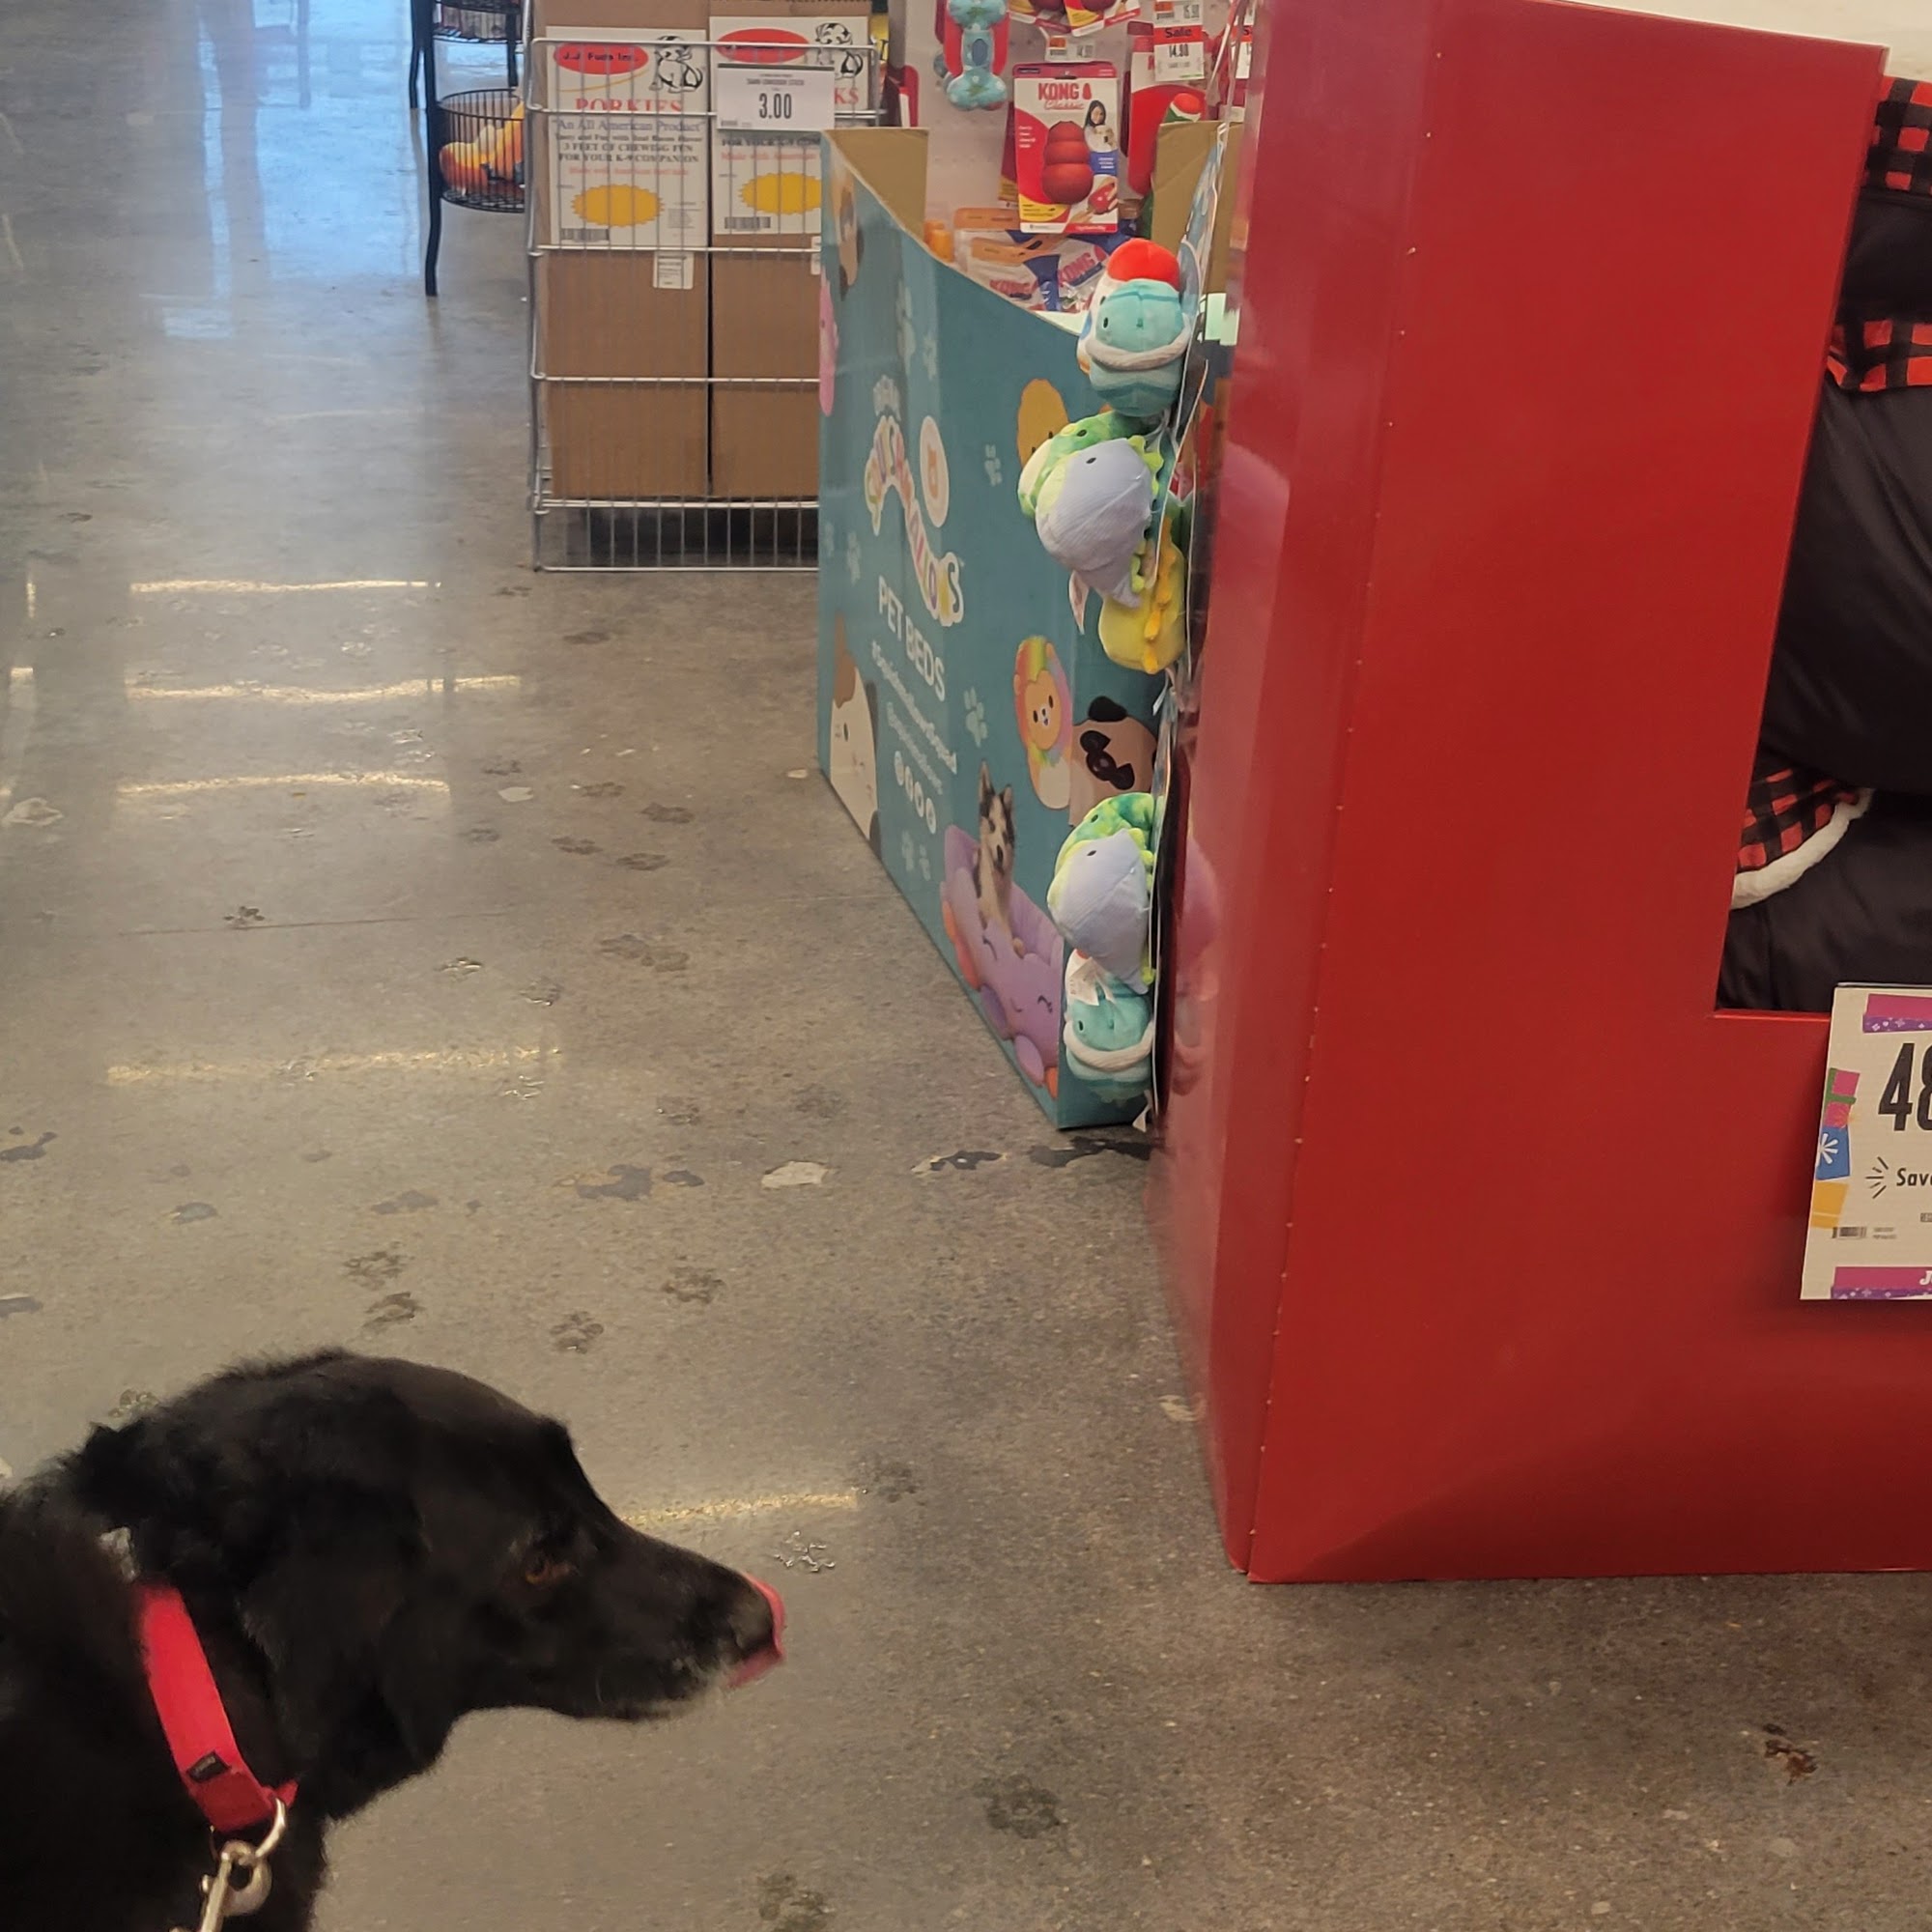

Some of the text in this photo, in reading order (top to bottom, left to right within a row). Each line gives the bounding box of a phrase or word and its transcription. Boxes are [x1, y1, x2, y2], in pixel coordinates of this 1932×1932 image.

[1165, 27, 1192, 38] Sale
[1037, 83, 1080, 100] KONG
[575, 98, 683, 112] PORKIES
[759, 93, 792, 119] 3.00
[599, 120, 653, 130] American
[878, 575, 904, 641] PET
[905, 614, 946, 702] BEDS
[1896, 1167, 1932, 1186] Sav
